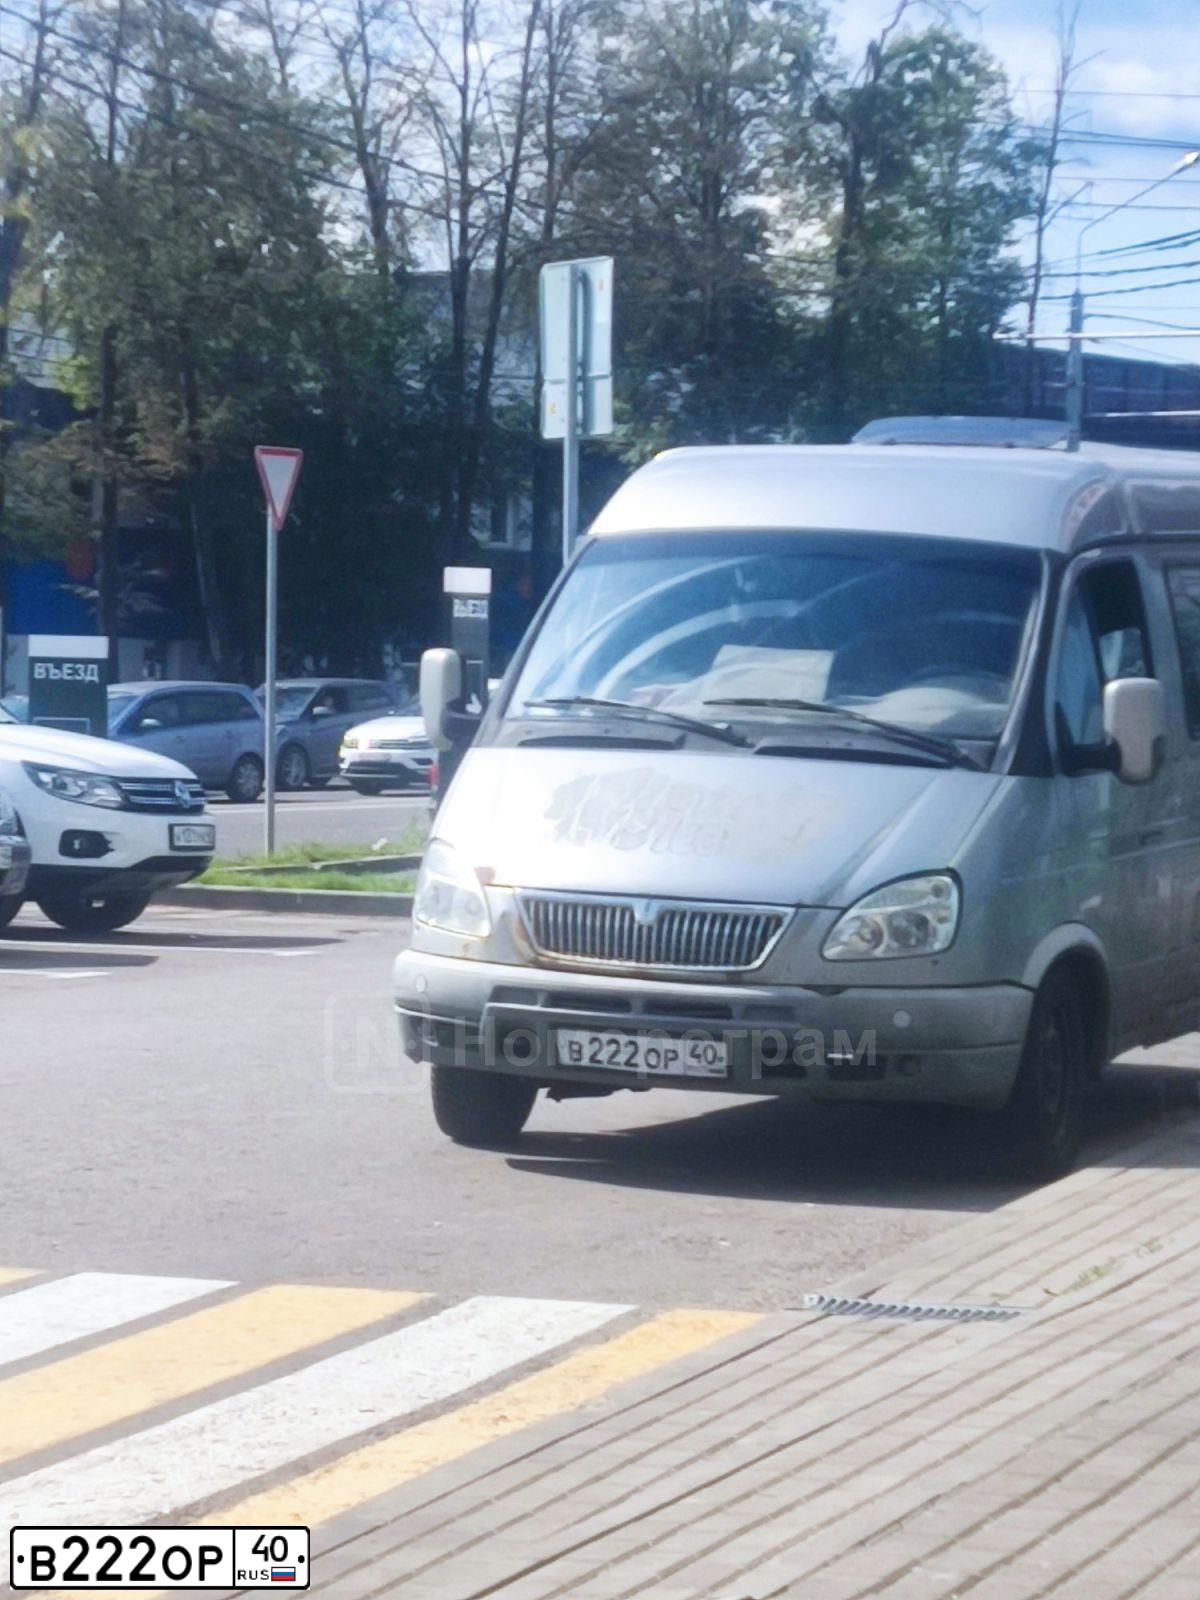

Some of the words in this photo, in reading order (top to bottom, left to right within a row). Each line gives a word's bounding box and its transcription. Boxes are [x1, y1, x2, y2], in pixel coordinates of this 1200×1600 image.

[34, 663, 99, 683] ВЪЕЗД
[568, 1036, 679, 1070] В222ОР
[689, 1042, 718, 1065] 40
